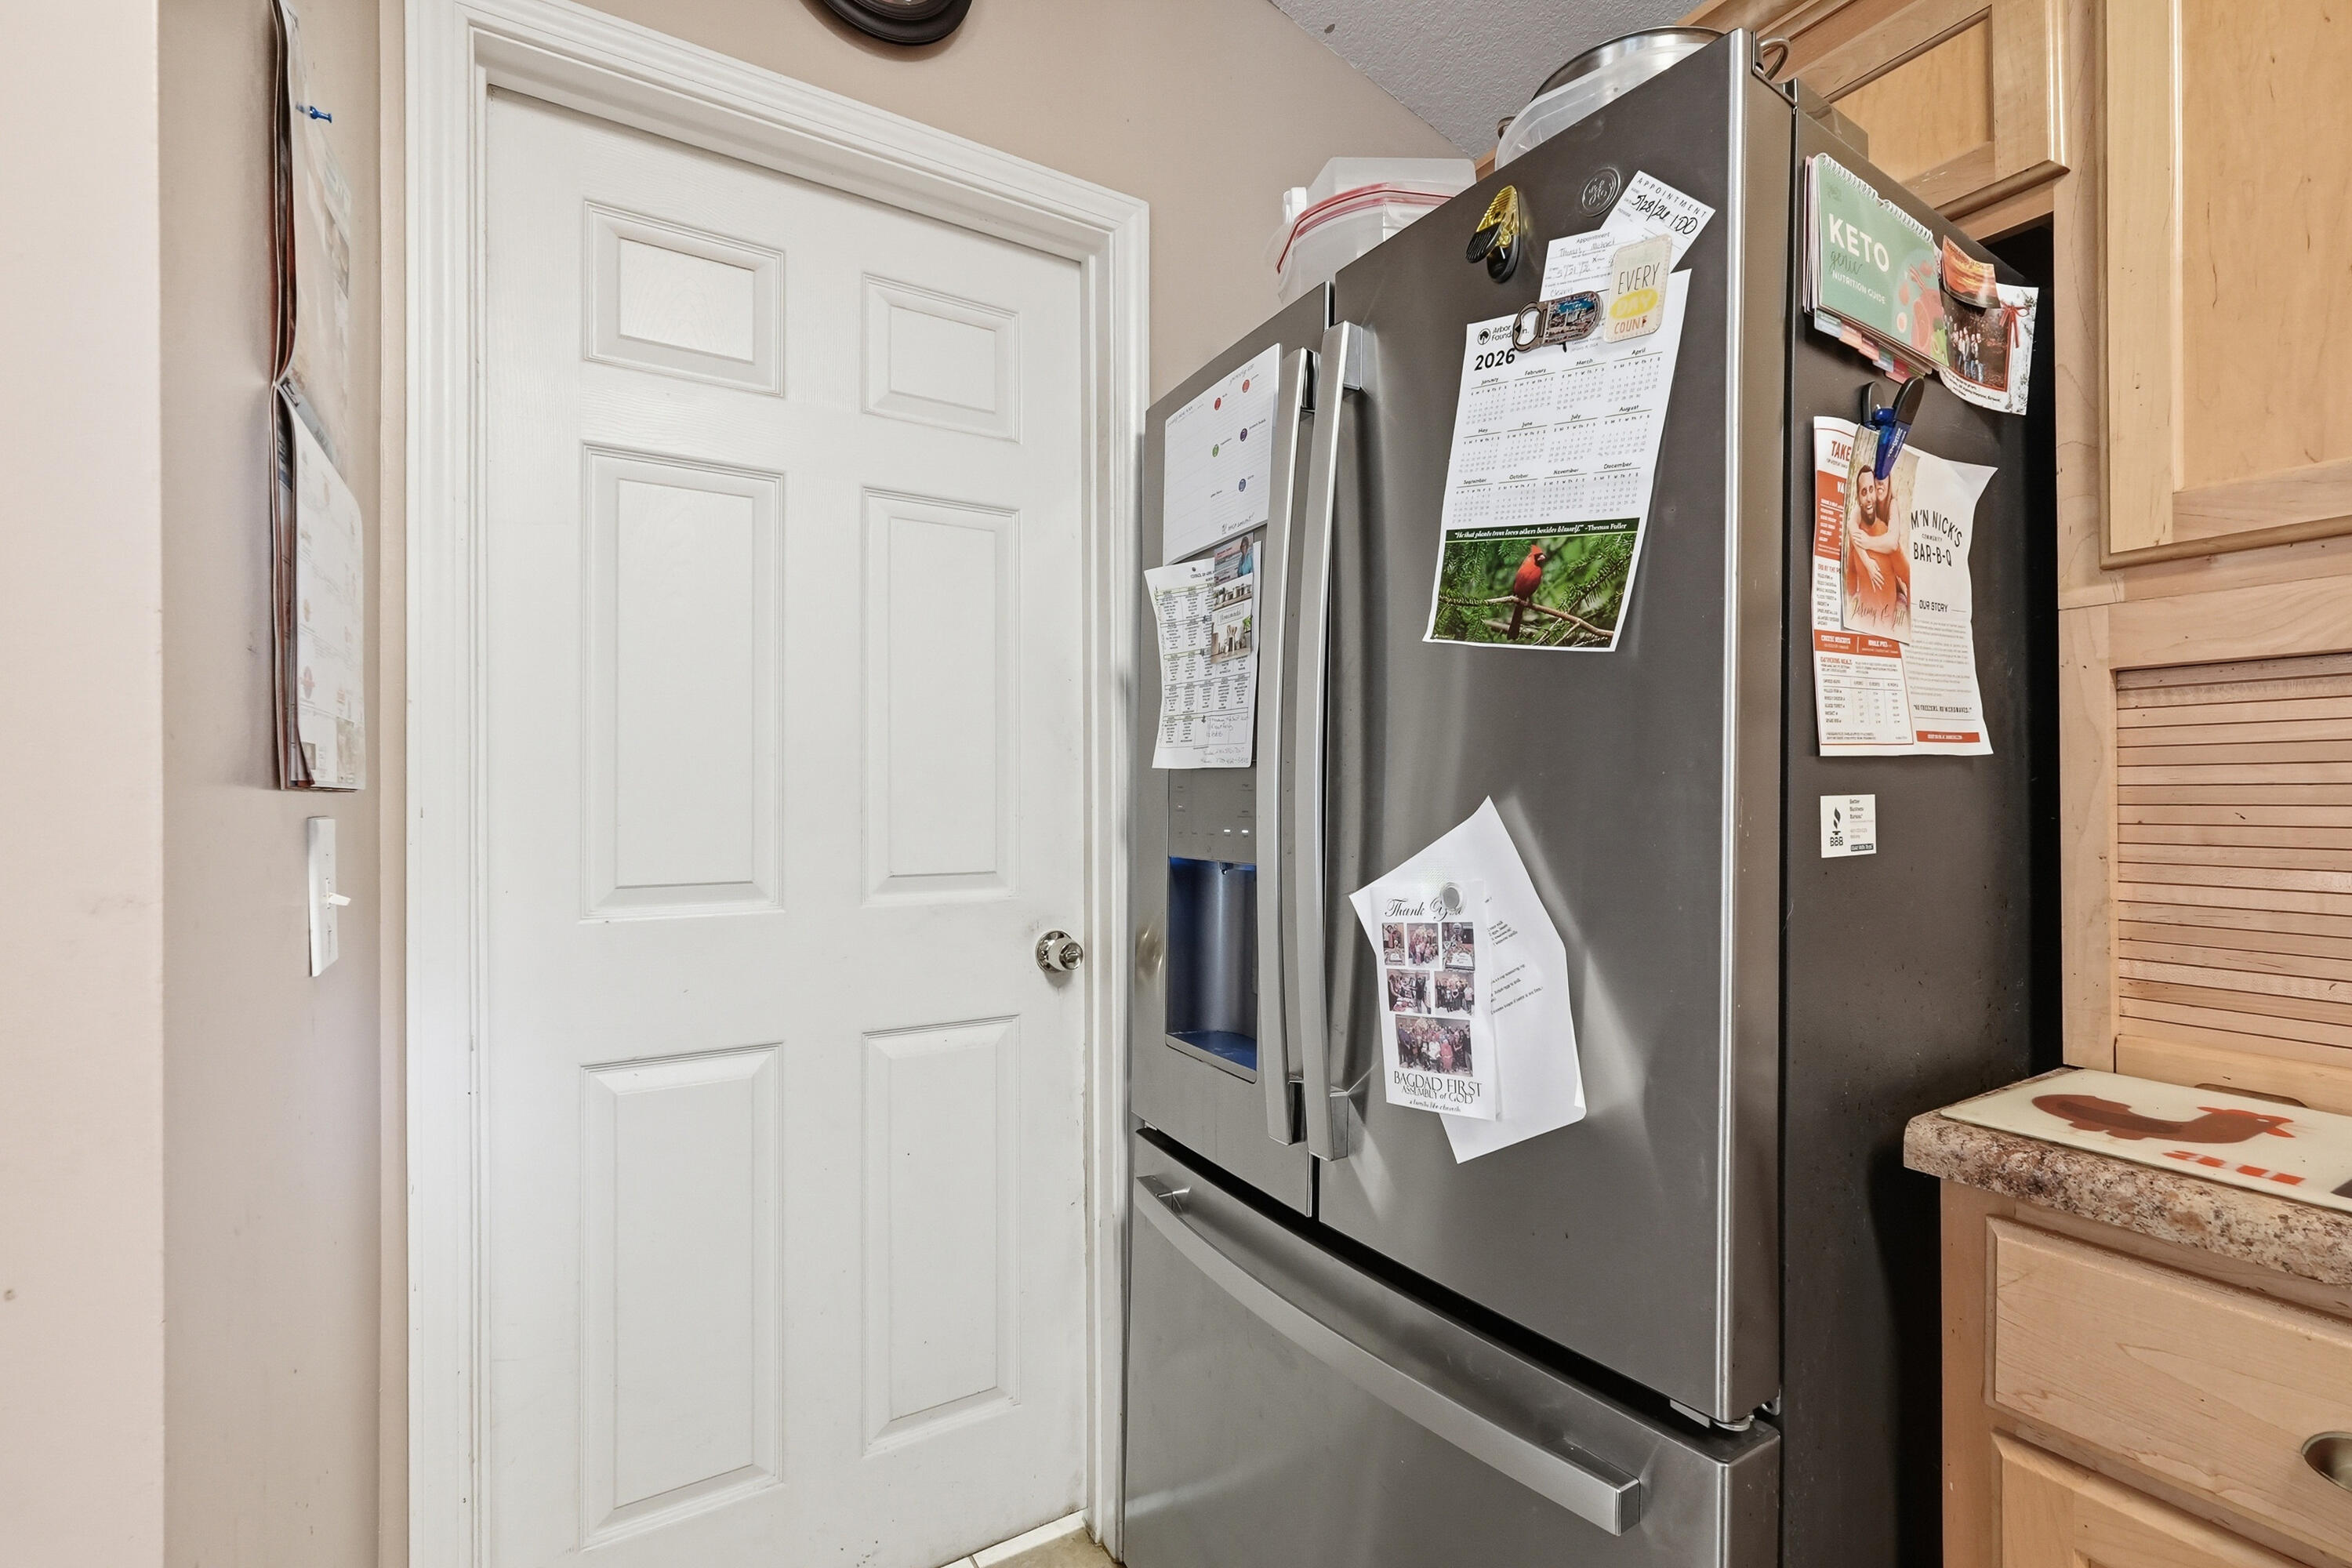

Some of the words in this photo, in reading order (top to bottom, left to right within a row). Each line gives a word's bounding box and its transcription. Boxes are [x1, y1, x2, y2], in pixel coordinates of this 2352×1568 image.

[1636, 177, 1707, 218] APPOINTMENT
[1828, 212, 1889, 272] KETO
[1617, 262, 1661, 295] EVERY
[1832, 269, 1867, 294] NUTRITION
[1492, 325, 1512, 334] Arbor
[1474, 347, 1515, 371] 2026
[1831, 440, 1852, 461] TAKE
[1932, 510, 1962, 547] NICK'S
[1913, 542, 1952, 567] BAR-B-Q
[1918, 600, 1930, 611] OUR
[1931, 601, 1949, 612] STORY
[1384, 898, 1425, 917] Thank
[1394, 1070, 1443, 1091] BAGDAD
[1446, 1078, 1483, 1097] FIRST
[1402, 1085, 1438, 1099] ASSEMBLY
[1448, 1092, 1474, 1105] GOD
